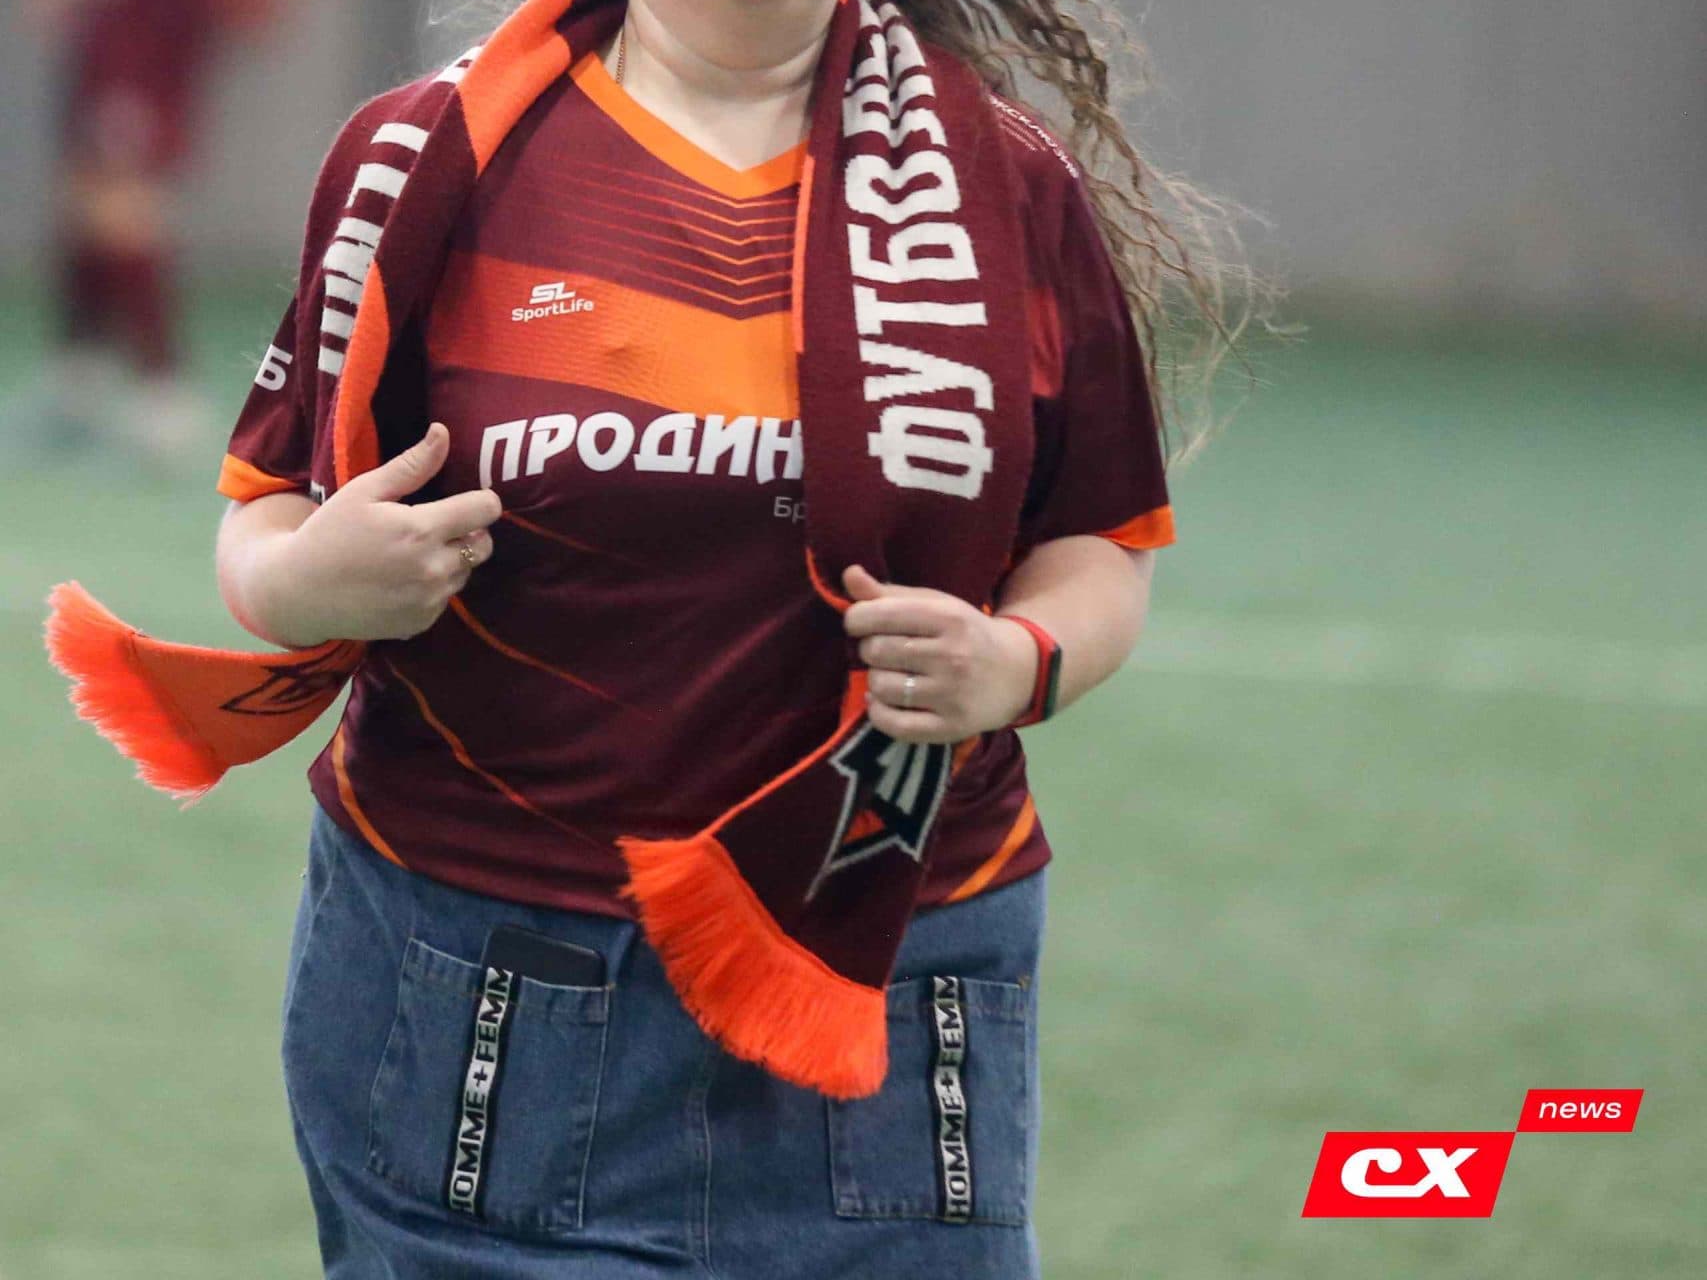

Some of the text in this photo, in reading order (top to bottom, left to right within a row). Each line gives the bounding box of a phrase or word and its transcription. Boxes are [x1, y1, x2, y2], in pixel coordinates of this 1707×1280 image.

[529, 281, 576, 305] SL
[511, 299, 595, 323] SportLife
[479, 411, 804, 489] ПРОДИН
